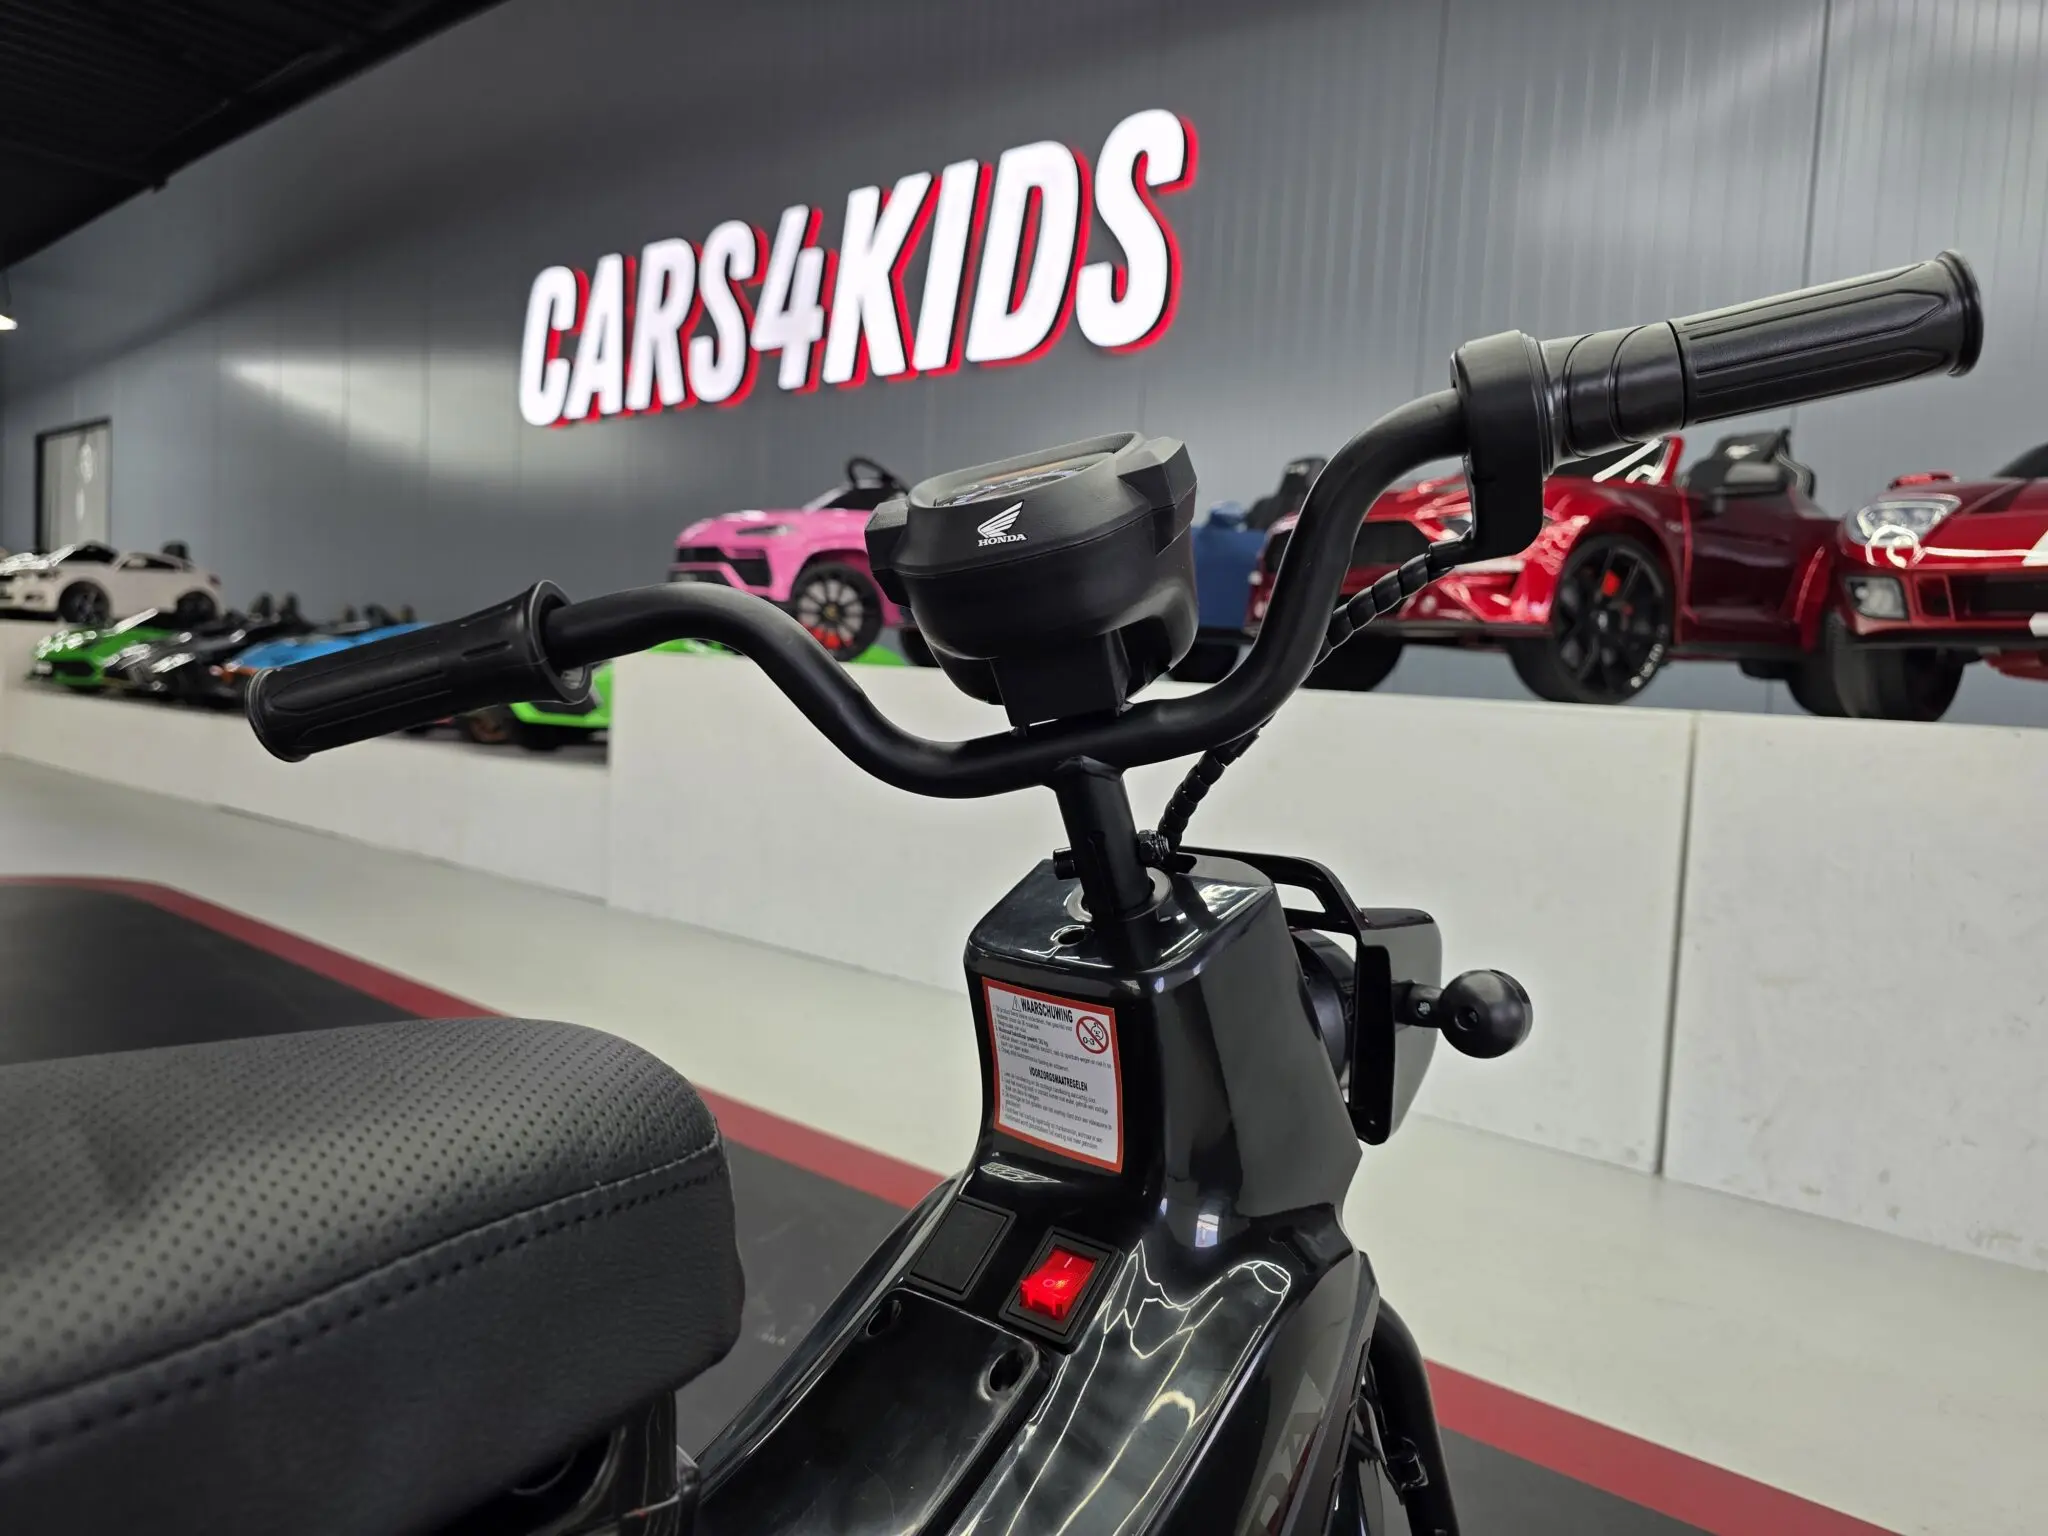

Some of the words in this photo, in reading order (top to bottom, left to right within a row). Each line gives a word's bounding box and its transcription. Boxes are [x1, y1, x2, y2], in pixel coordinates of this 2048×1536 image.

[519, 108, 1197, 428] CARS4KIDS
[978, 534, 1027, 546] HONDA
[1020, 998, 1073, 1022] WAARSCHUWING
[1082, 1036, 1095, 1046] 0-3
[1028, 1066, 1088, 1091] VOORZORGSMAATREGELEN
